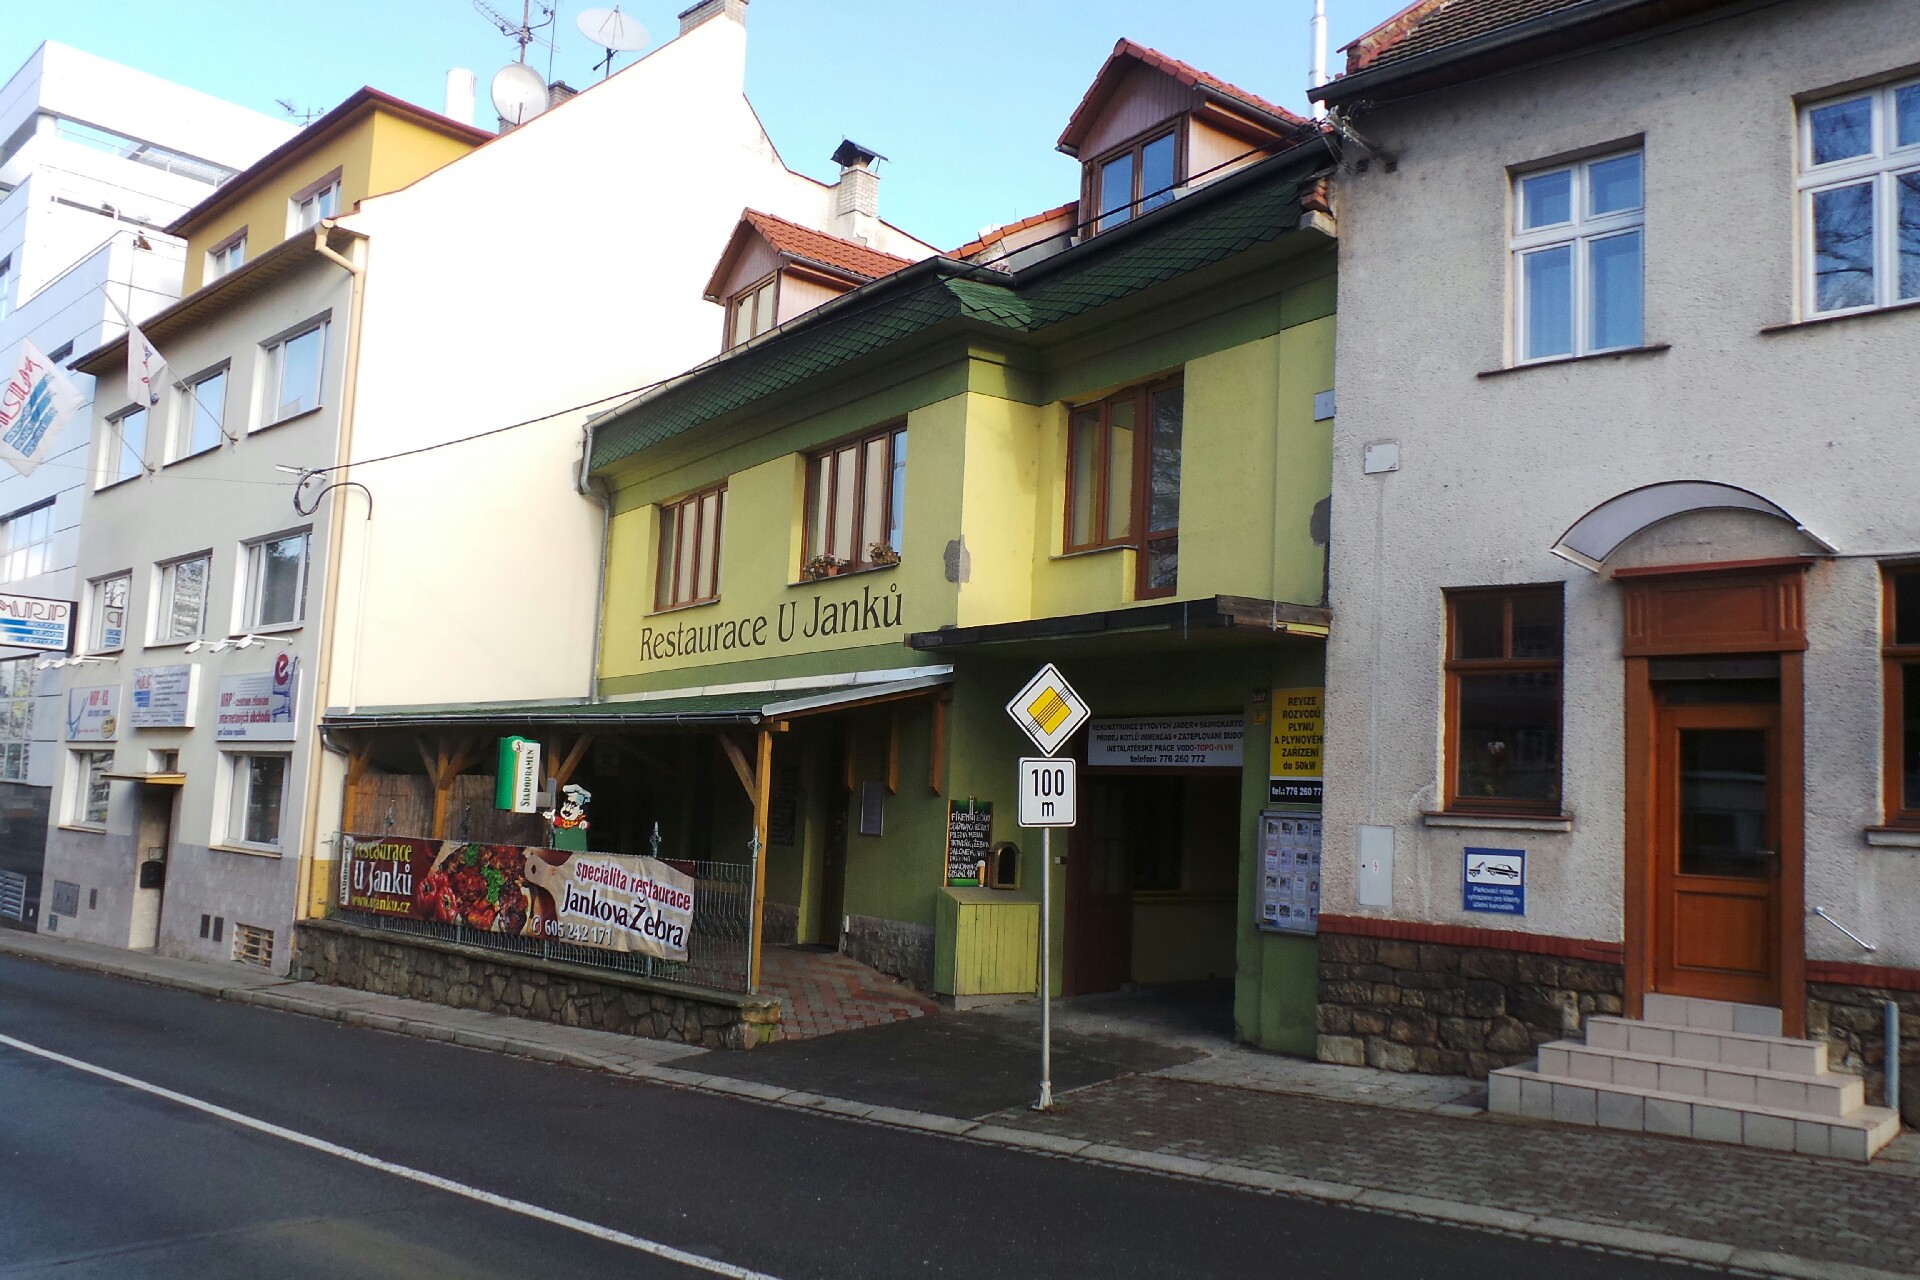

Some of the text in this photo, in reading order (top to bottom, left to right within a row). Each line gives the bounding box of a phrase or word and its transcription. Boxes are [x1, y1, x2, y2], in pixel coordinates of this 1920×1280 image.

[639, 582, 903, 661] Restaurace U Janků
[1288, 697, 1316, 706] REVIZE
[1283, 706, 1321, 719] ROZVODŮ
[1288, 722, 1314, 732] PLYNU
[1096, 733, 1119, 742] PRODEJ
[1140, 732, 1172, 741] IMMERGAS
[1274, 733, 1323, 745] A PLYNOVÉH
[1130, 754, 1206, 763] telefon: 776 260 772
[1283, 761, 1316, 770] do 50kW
[520, 749, 534, 807] STAROPRAMEN
[1031, 768, 1065, 797] 100
[1286, 786, 1298, 796] 776
[1299, 786, 1312, 796] 260
[1313, 787, 1323, 796] 77
[1041, 801, 1055, 817] m
[355, 842, 412, 862] restaurace
[354, 860, 413, 896] U Janků
[576, 861, 691, 911] specialita restaurace
[561, 883, 684, 947] Jankova Žebra
[544, 918, 612, 945] 605 242 171
